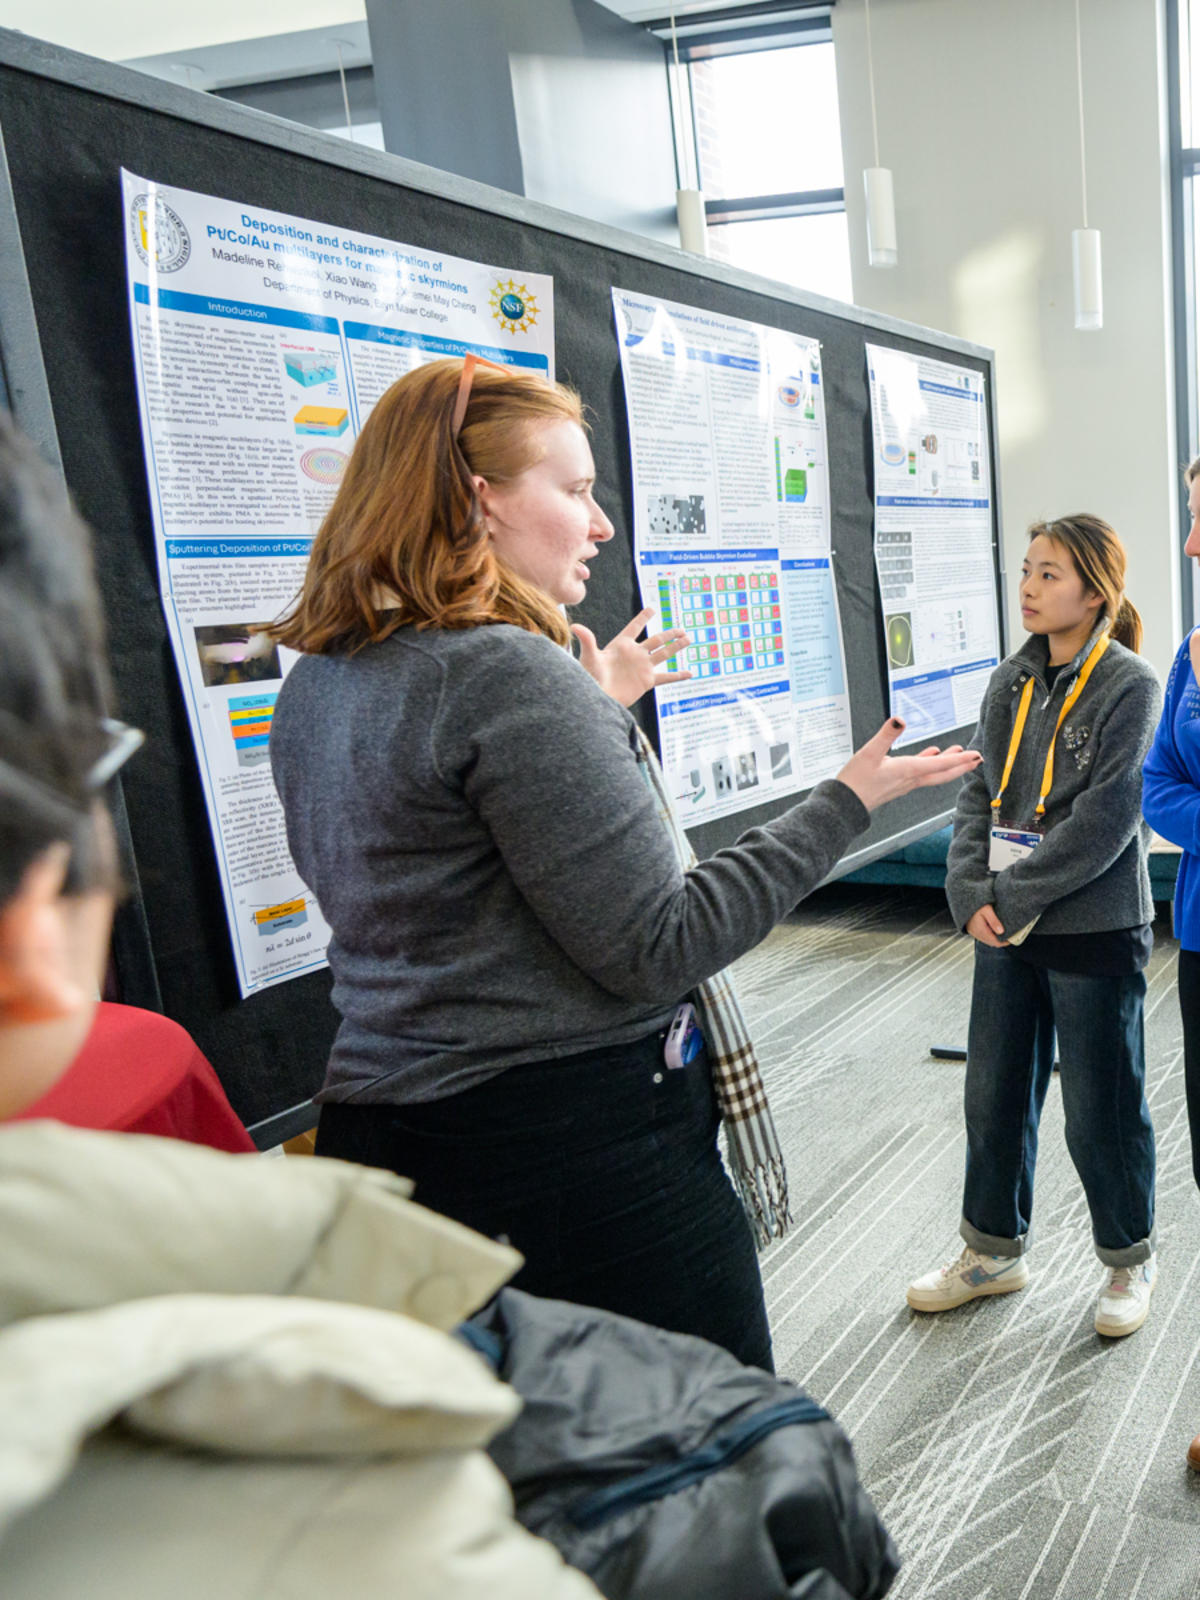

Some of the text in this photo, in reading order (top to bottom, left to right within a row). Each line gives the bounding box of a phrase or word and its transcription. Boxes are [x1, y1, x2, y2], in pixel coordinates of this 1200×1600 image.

[206, 225, 270, 250] Pt/Co/Au
[274, 242, 343, 266] multilayers
[346, 256, 362, 270] for
[418, 274, 468, 294] skyrmions
[241, 214, 313, 242] Deposition
[316, 234, 340, 248] and
[342, 240, 430, 271] charactization
[432, 261, 443, 272] of
[212, 248, 264, 268] Madeline
[325, 271, 348, 285] Xiao
[451, 298, 477, 314] Cheng
[208, 301, 268, 319] Introduction
[322, 290, 332, 300] of
[419, 308, 448, 323] College
[501, 300, 523, 313] NSF
[168, 544, 218, 555] Sputtering
[220, 544, 271, 554] Deposition
